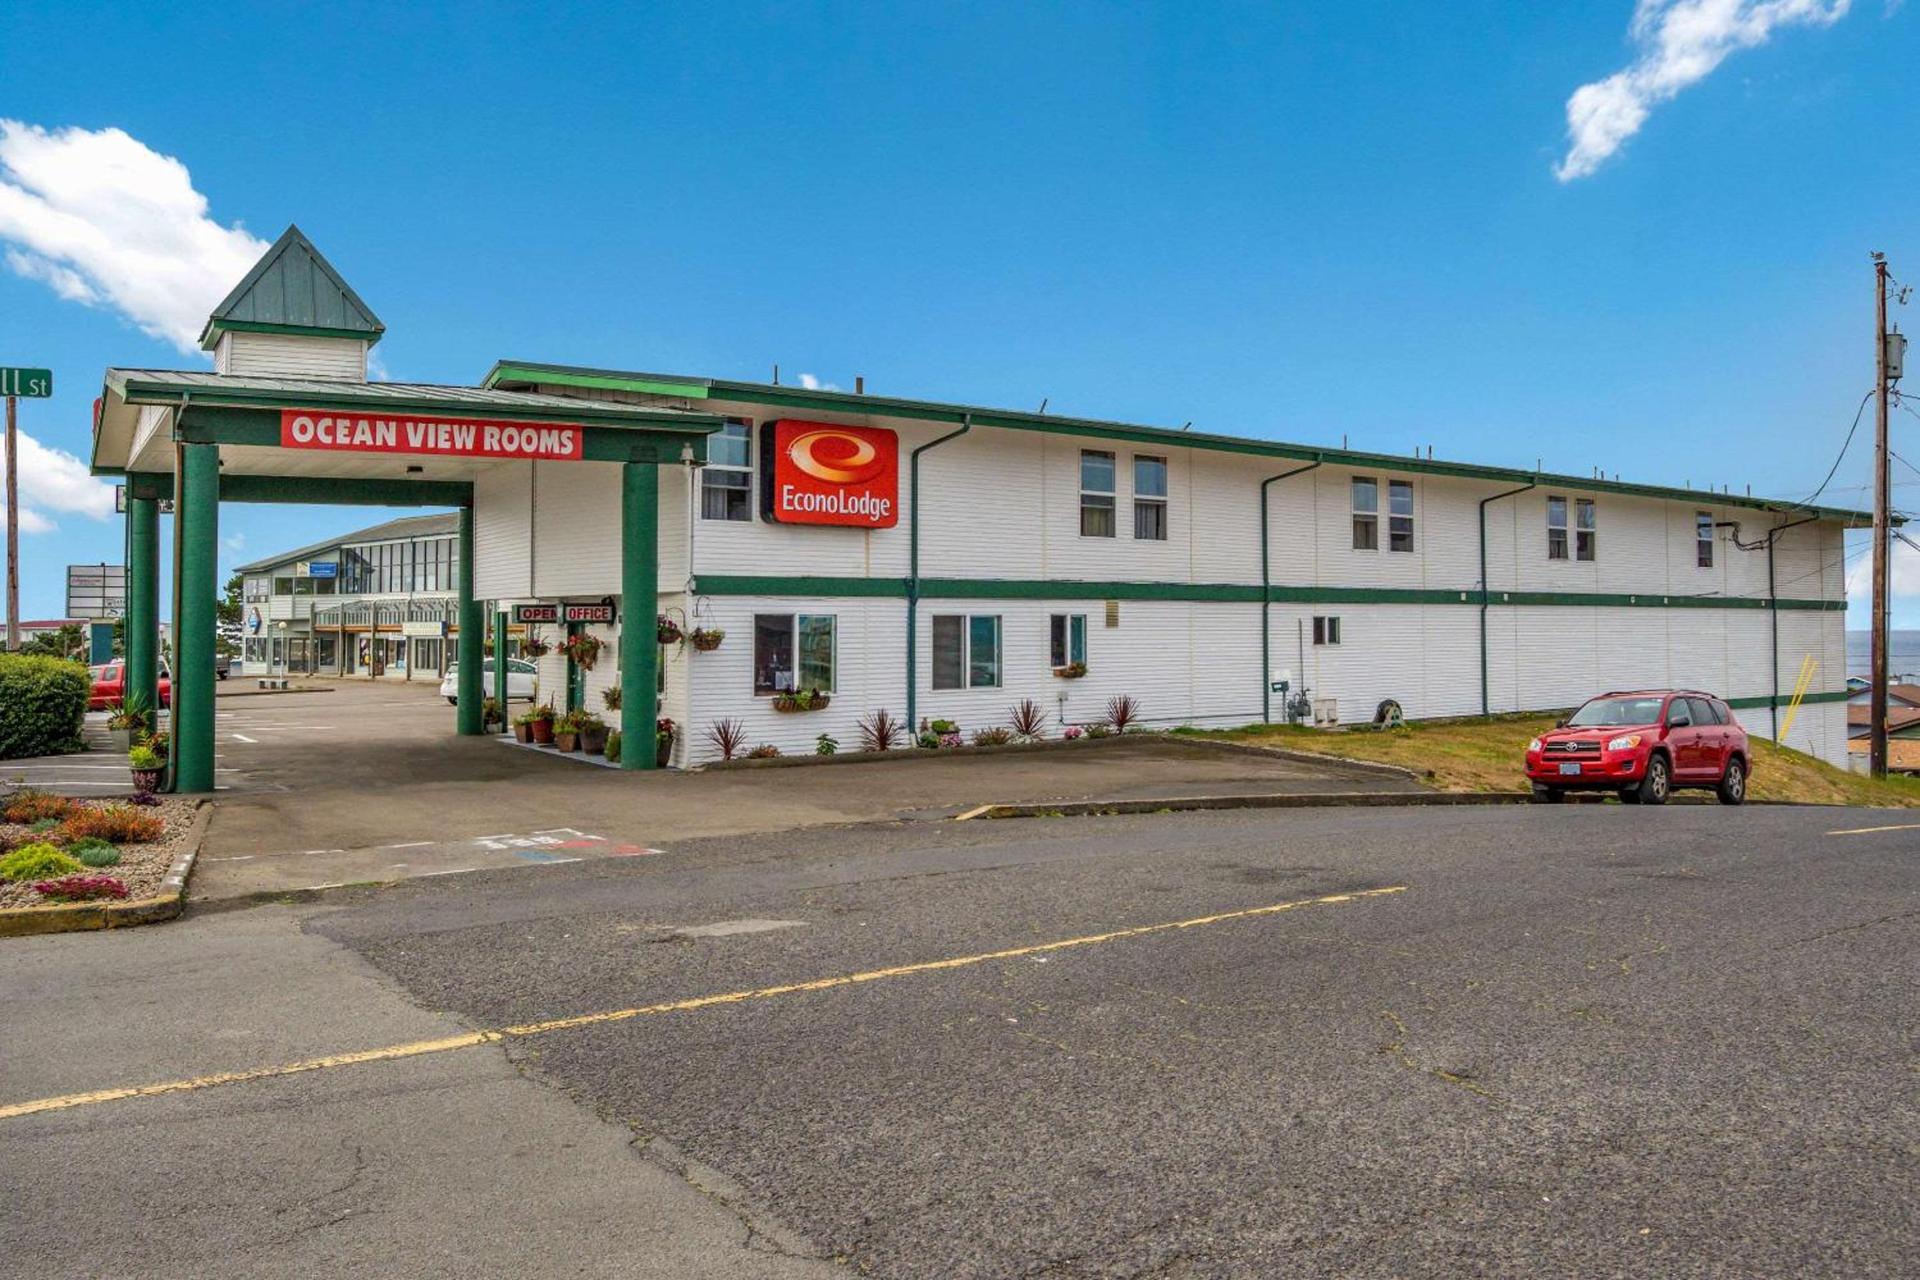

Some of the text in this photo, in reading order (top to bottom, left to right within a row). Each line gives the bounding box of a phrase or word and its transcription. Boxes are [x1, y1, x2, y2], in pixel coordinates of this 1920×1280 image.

[29, 378, 47, 396] St
[292, 416, 574, 455] OCEAN VIEW ROOMS
[782, 484, 891, 521] EconoLodge
[568, 607, 609, 619] OFFICE
